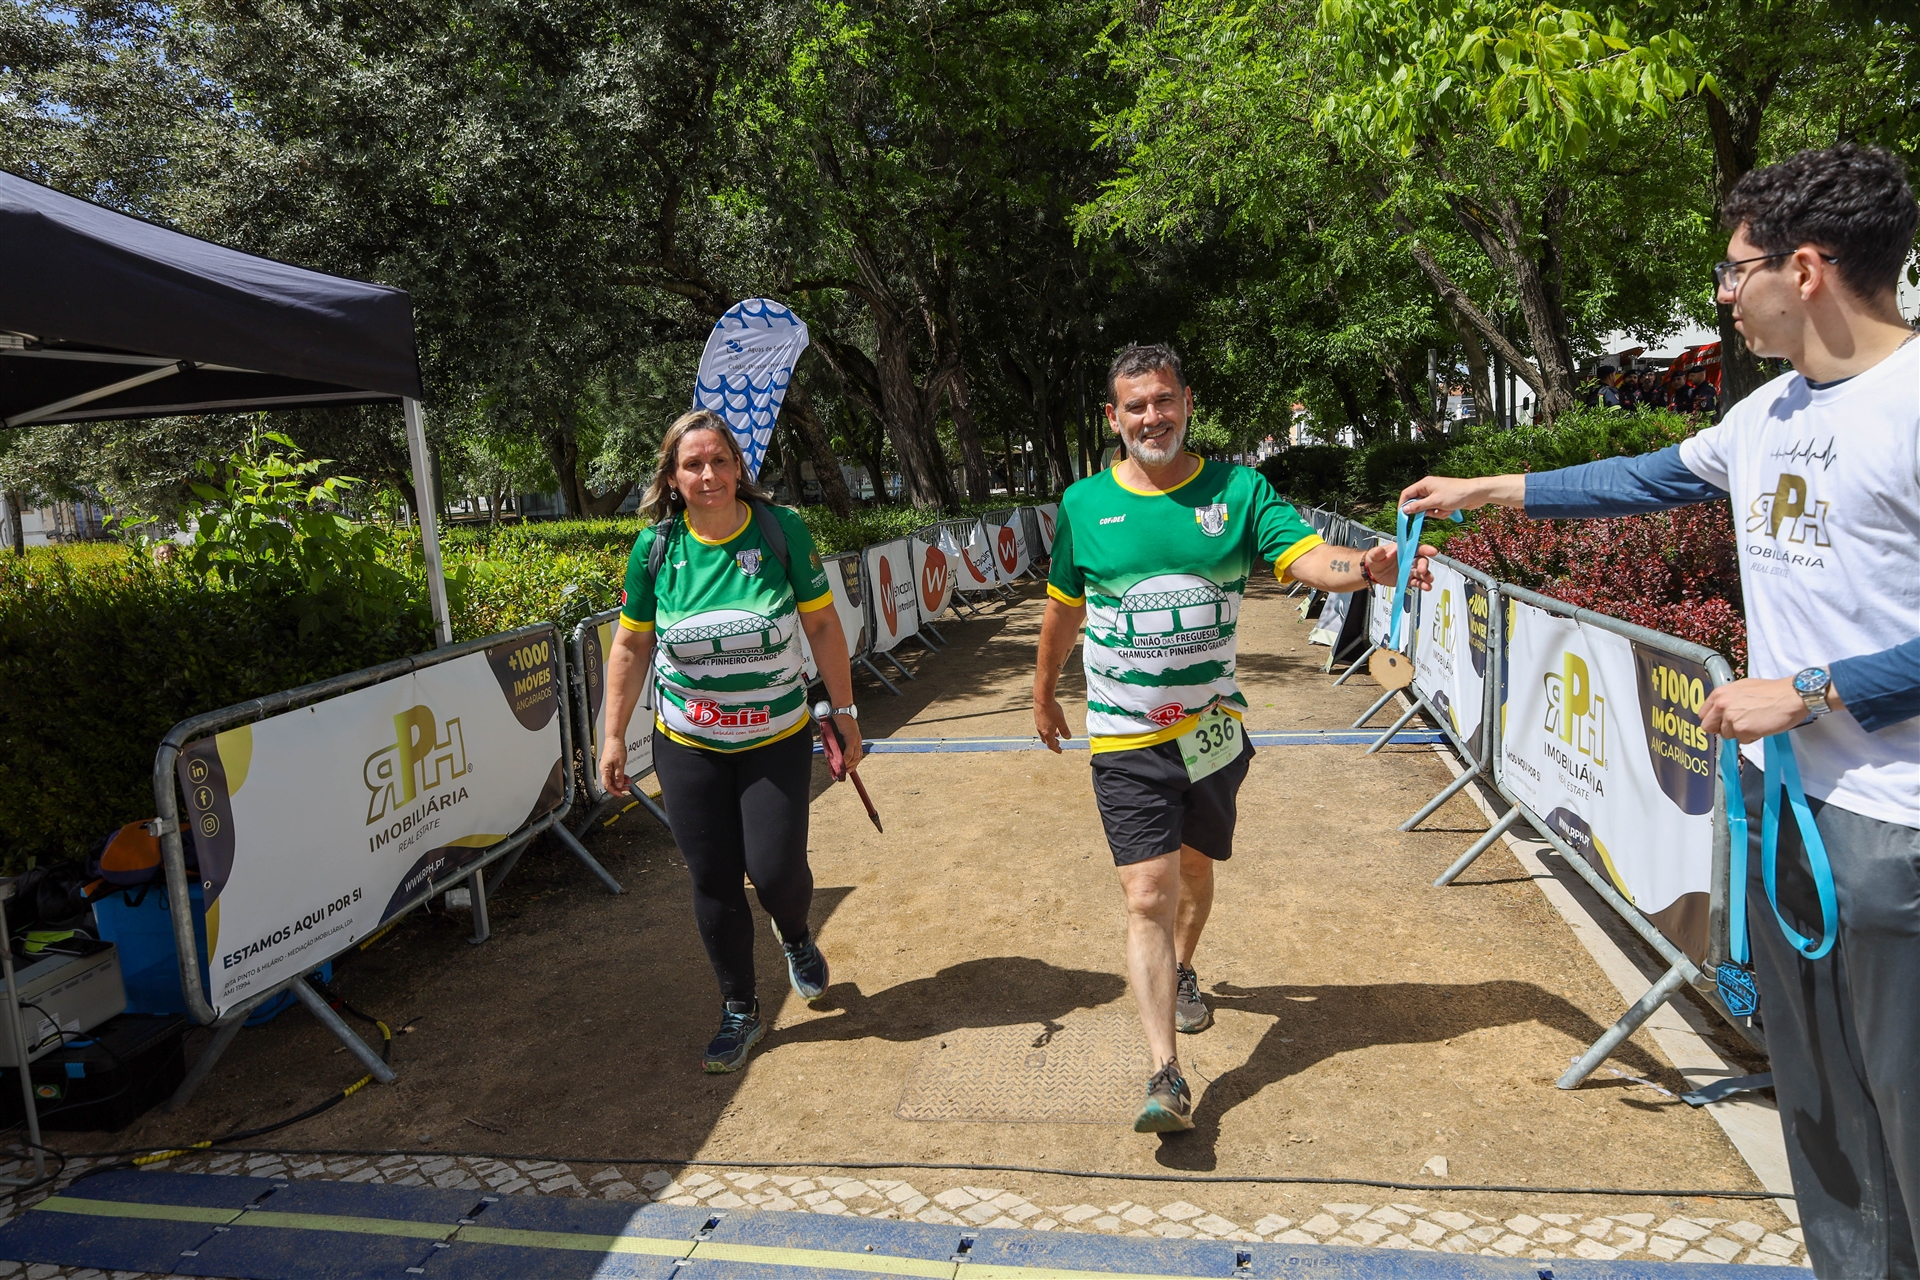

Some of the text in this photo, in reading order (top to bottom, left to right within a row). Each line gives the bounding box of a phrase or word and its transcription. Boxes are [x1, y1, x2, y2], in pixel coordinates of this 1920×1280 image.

[926, 565, 945, 593] W
[1750, 562, 1769, 574] REAL
[1118, 650, 1163, 659] CHAMUSCA
[1169, 644, 1208, 656] PINHEIRO
[1208, 638, 1228, 650] GRANDE
[1134, 636, 1160, 646] UNIÃO
[1176, 628, 1219, 643] FREGUESIAS
[509, 640, 549, 672] +1000
[711, 656, 747, 666] PINHEIRO
[748, 653, 778, 663] GRANDE
[513, 667, 551, 697] IMÓVEIS
[1651, 665, 1705, 715] +1000
[516, 686, 552, 712] ANGARIADOS
[1196, 717, 1234, 754] 336
[1651, 705, 1708, 751] IMÓVEIS
[628, 739, 643, 753] AQUI
[1651, 736, 1709, 777] ANGARIADOS
[1567, 782, 1590, 801] ESTATE
[369, 786, 469, 853] IMOBILIÁRIA
[398, 818, 441, 853] REAL ESTATE
[404, 857, 445, 893] WWW.RPH.PT
[223, 887, 362, 970] ESTAMOS AQUI POR SI
[224, 978, 237, 990] RITA
[237, 968, 256, 983] PINTO
[261, 954, 284, 971] HILÁRIO
[344, 918, 354, 928] LDA
[223, 980, 251, 998] AMI 11994
